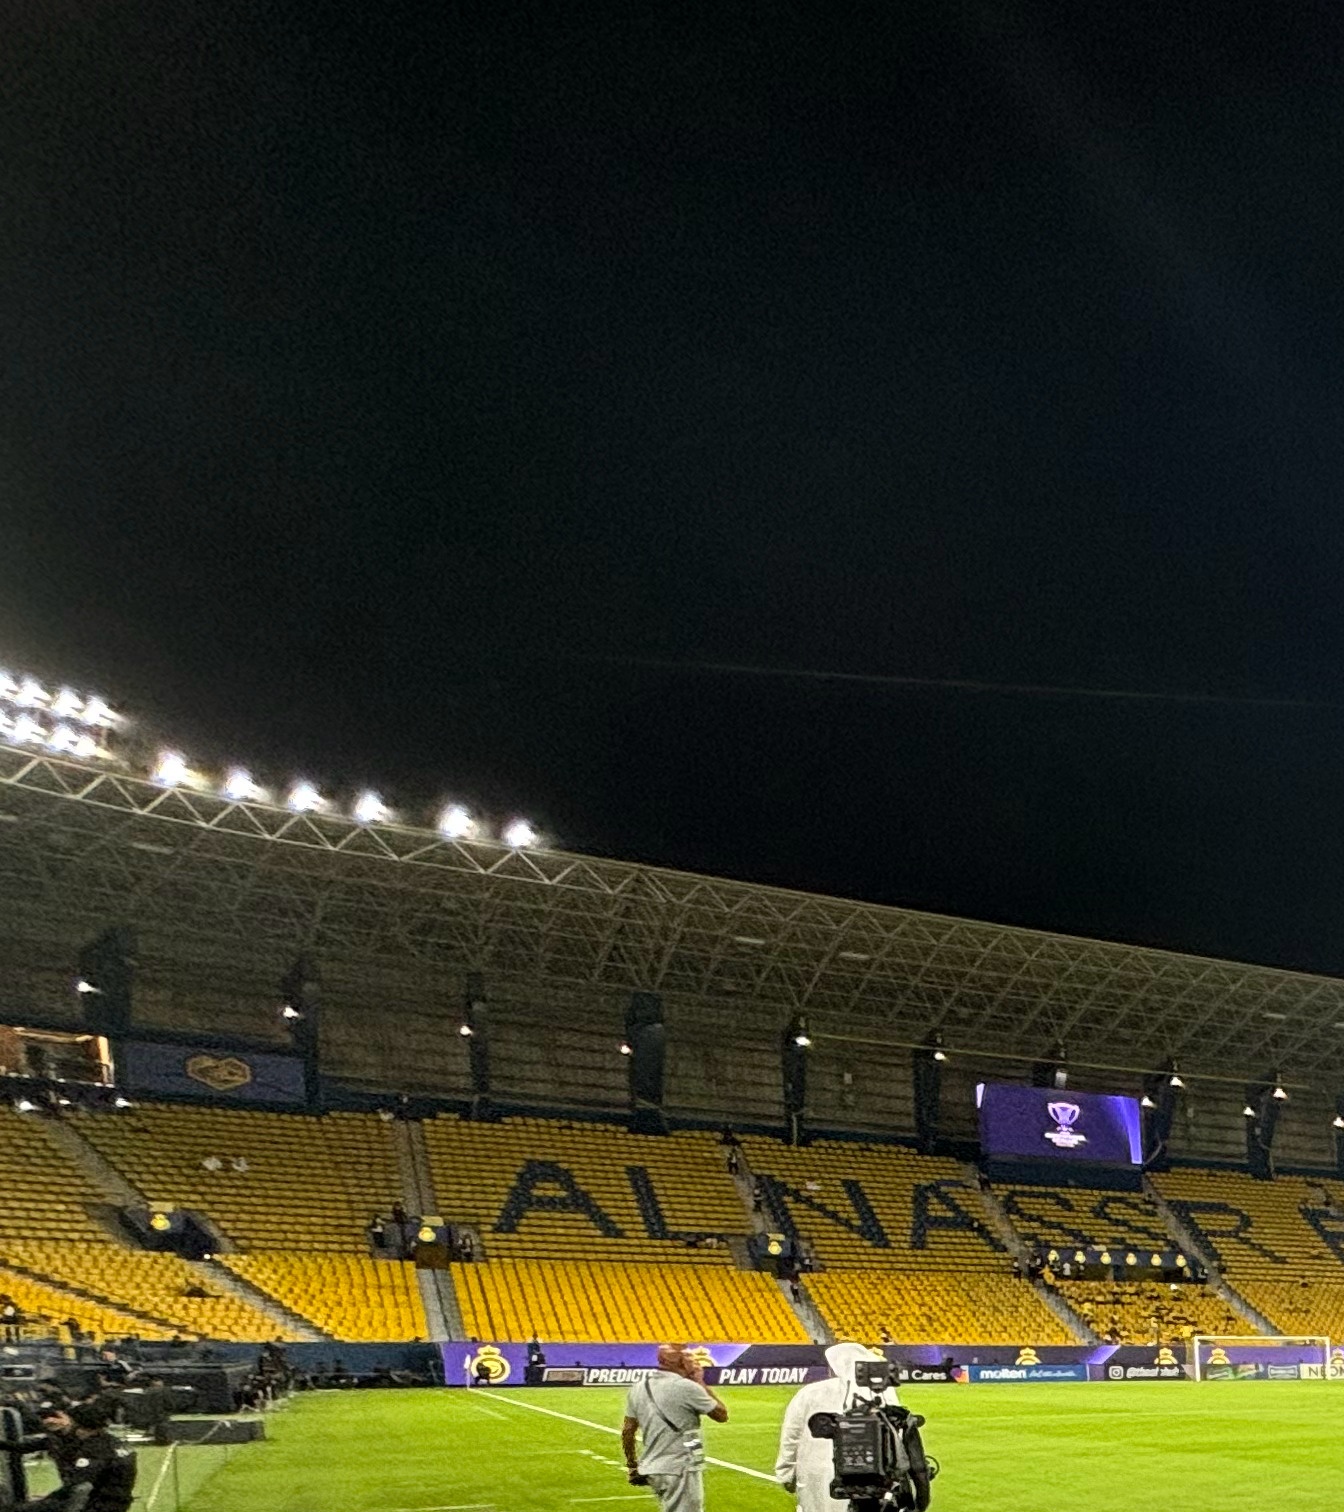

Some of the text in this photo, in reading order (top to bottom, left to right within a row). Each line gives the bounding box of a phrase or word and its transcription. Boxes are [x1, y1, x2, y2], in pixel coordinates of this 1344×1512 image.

[493, 1160, 728, 1241] AL
[718, 1368, 757, 1384] PLAY
[760, 1367, 808, 1384] TODAY
[911, 1369, 947, 1380] Cares
[980, 1368, 1027, 1379] molten
